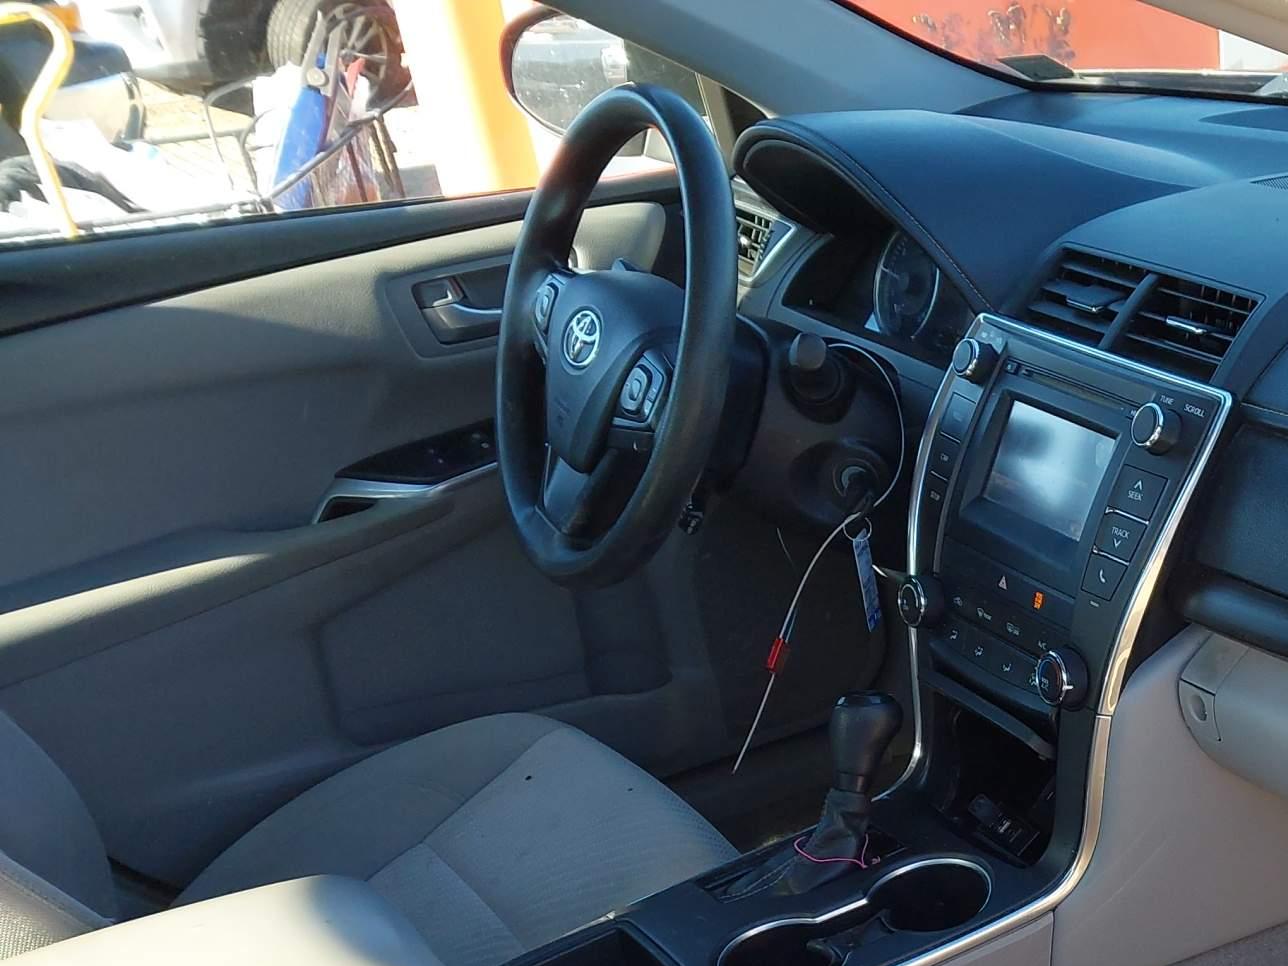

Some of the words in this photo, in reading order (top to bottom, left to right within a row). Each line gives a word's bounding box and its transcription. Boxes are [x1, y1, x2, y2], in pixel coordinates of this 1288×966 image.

[1159, 395, 1175, 405] TUNE
[1183, 403, 1206, 418] SCROLL
[1127, 490, 1144, 502] SEEK
[1111, 526, 1130, 540] TRACK
